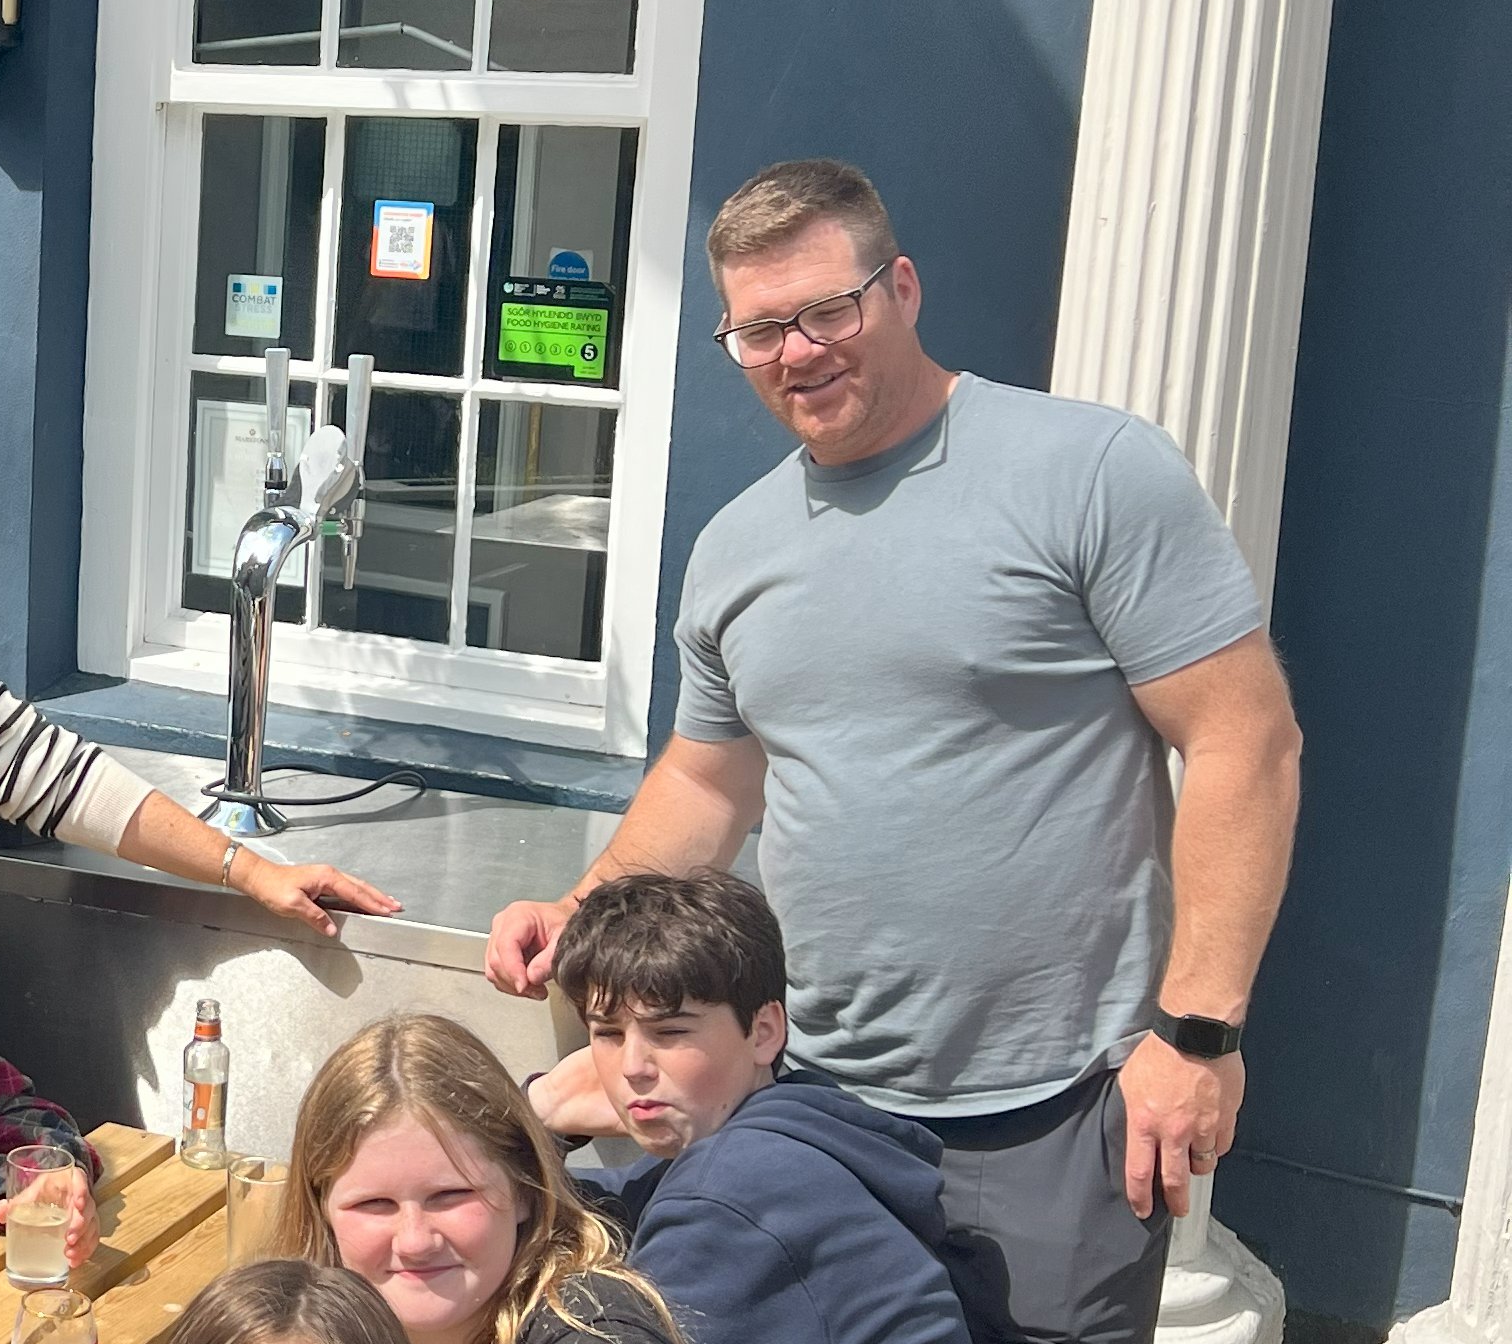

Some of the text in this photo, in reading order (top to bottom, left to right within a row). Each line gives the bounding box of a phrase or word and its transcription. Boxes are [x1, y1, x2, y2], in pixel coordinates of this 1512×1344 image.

[232, 294, 276, 305] COMBAT
[507, 318, 601, 332] FOOD HYGIENE RATING
[583, 346, 595, 360] 5
